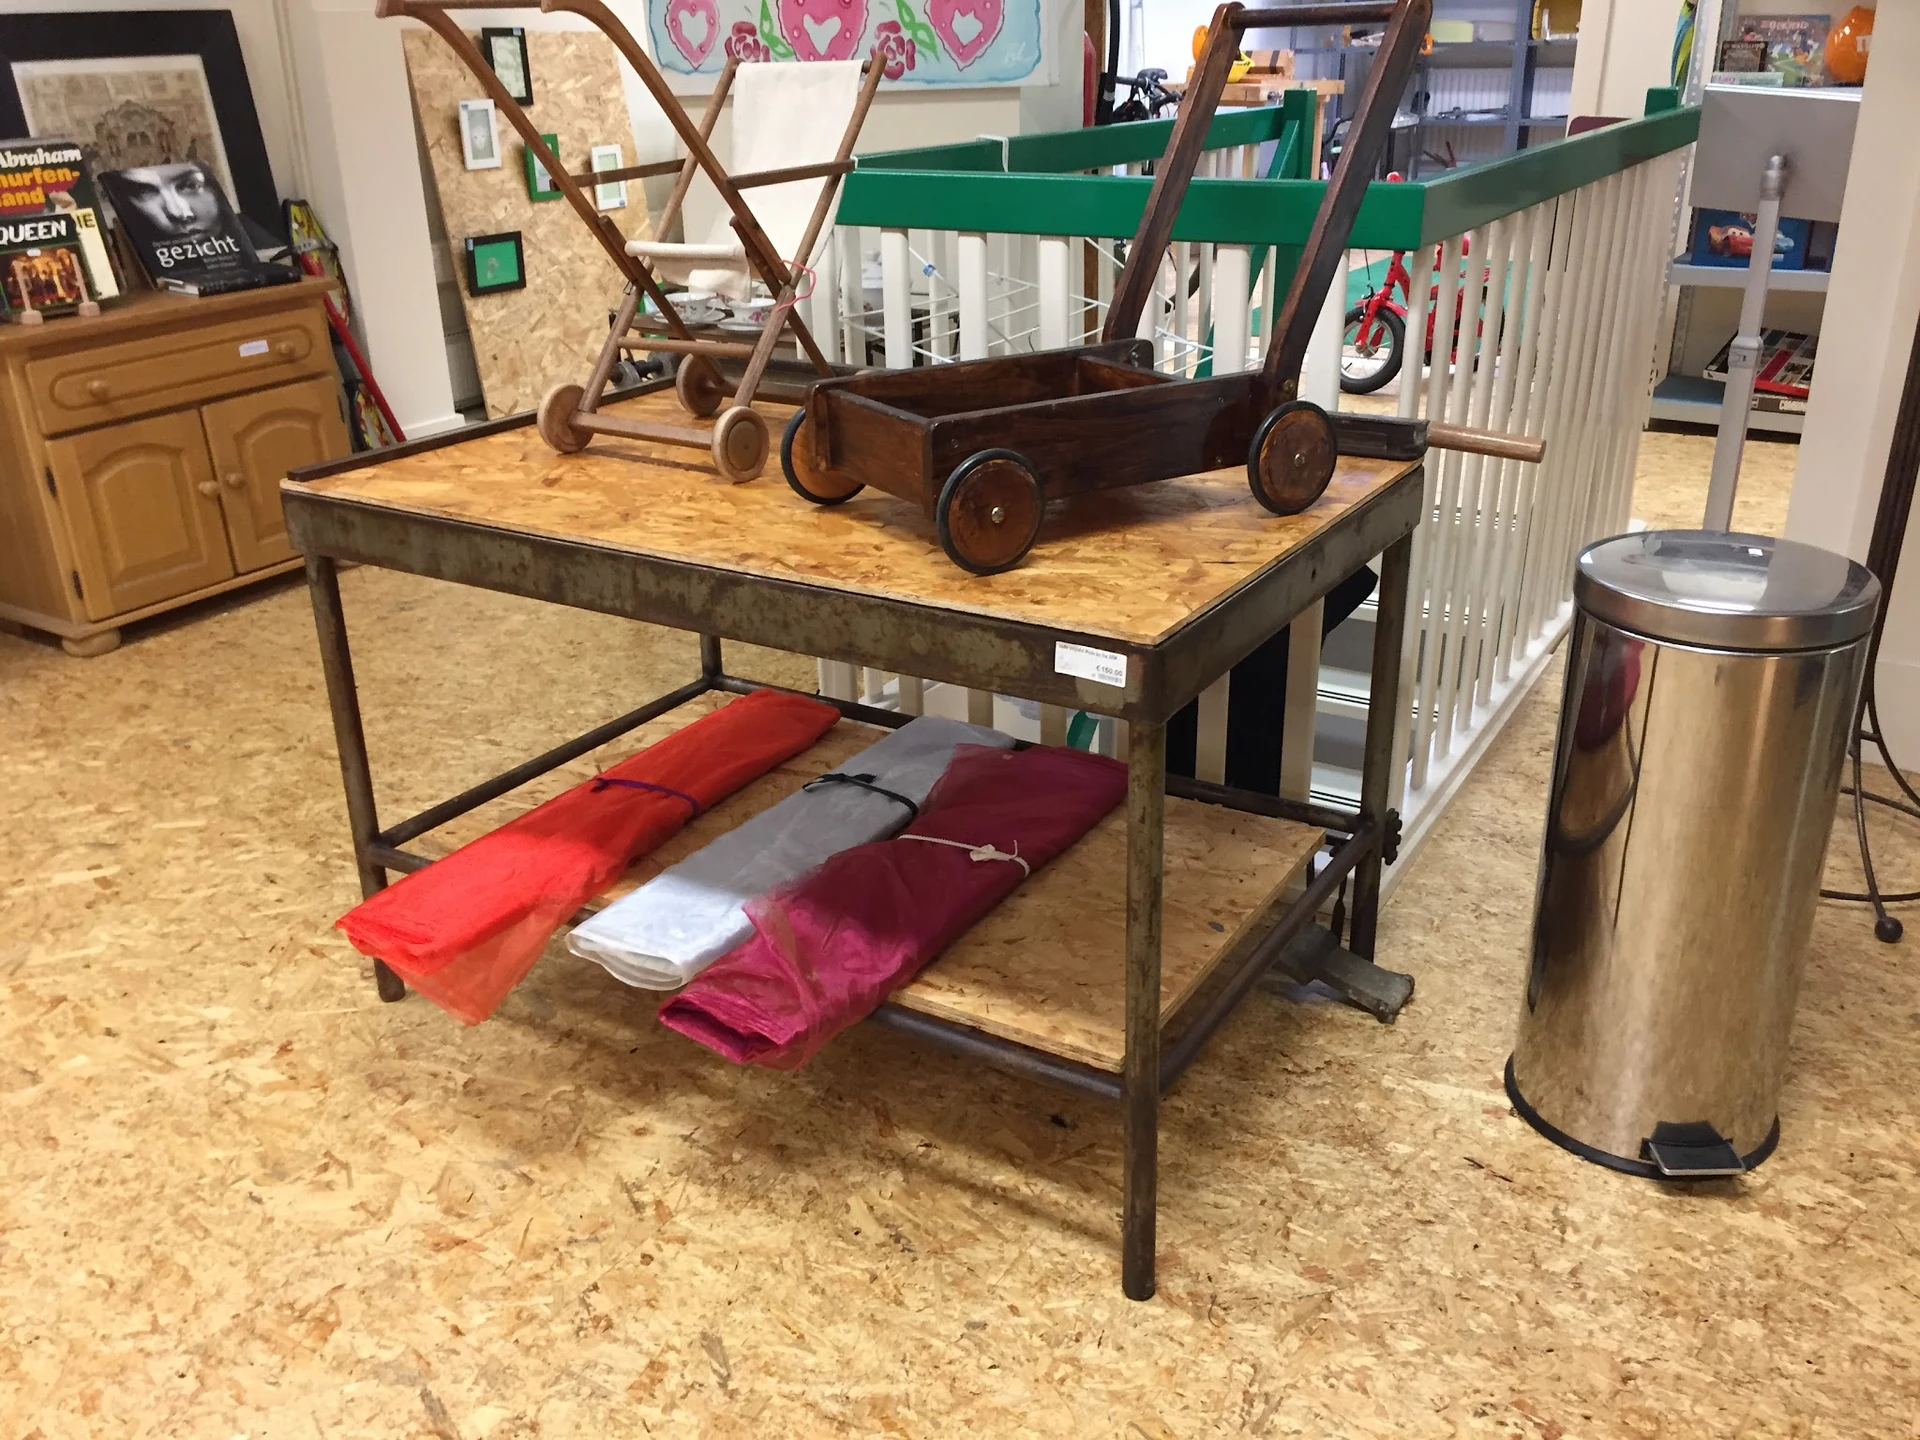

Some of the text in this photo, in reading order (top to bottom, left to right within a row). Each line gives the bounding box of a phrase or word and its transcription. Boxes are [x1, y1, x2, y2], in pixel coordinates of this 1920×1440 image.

[0, 148, 82, 168] Abraham
[0, 186, 46, 208] and
[0, 220, 67, 246] QUEEN
[156, 234, 240, 267] gezicht
